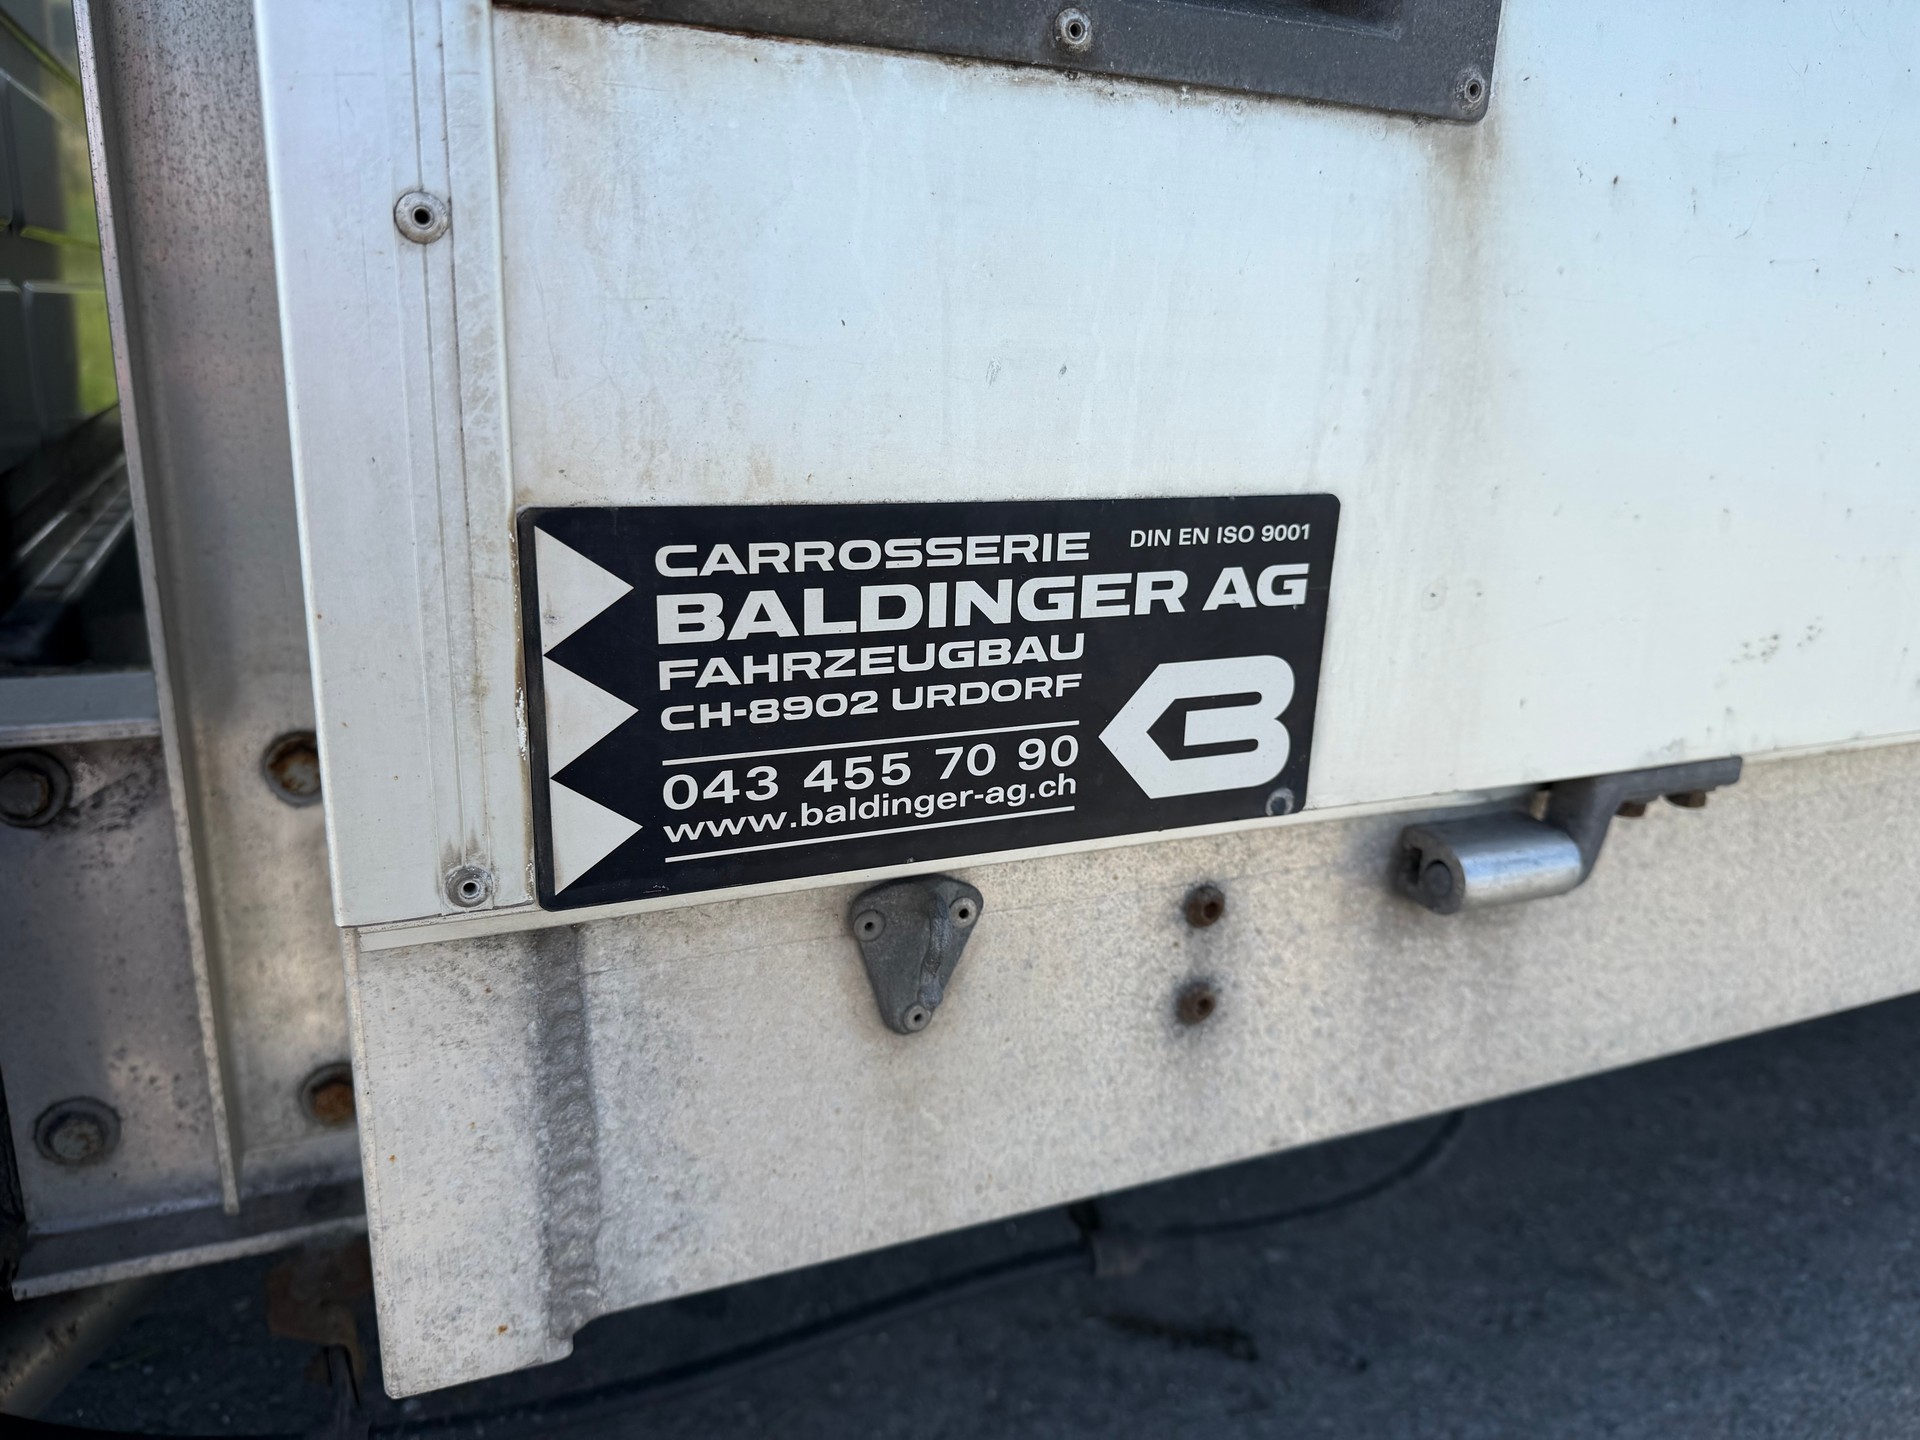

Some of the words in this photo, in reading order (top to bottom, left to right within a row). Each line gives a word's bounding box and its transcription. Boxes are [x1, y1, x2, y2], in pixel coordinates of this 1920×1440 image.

[654, 532, 1091, 578] CARROSSERIE
[1130, 529, 1172, 547] DIN
[1178, 527, 1210, 546] EN
[1216, 525, 1255, 544] ISO
[1261, 523, 1310, 542] 9001
[656, 569, 1189, 645] BALDINGER
[1202, 563, 1310, 611] AG
[658, 632, 1086, 691] FAHRZEUGBAU
[660, 690, 879, 732] CH-8902
[892, 673, 1083, 716] URDORF
[662, 765, 779, 811] 043
[803, 751, 912, 793] 455
[935, 743, 996, 780] 70
[1018, 734, 1079, 771] 90
[662, 773, 1077, 843] www.baldinger-ag.ch
